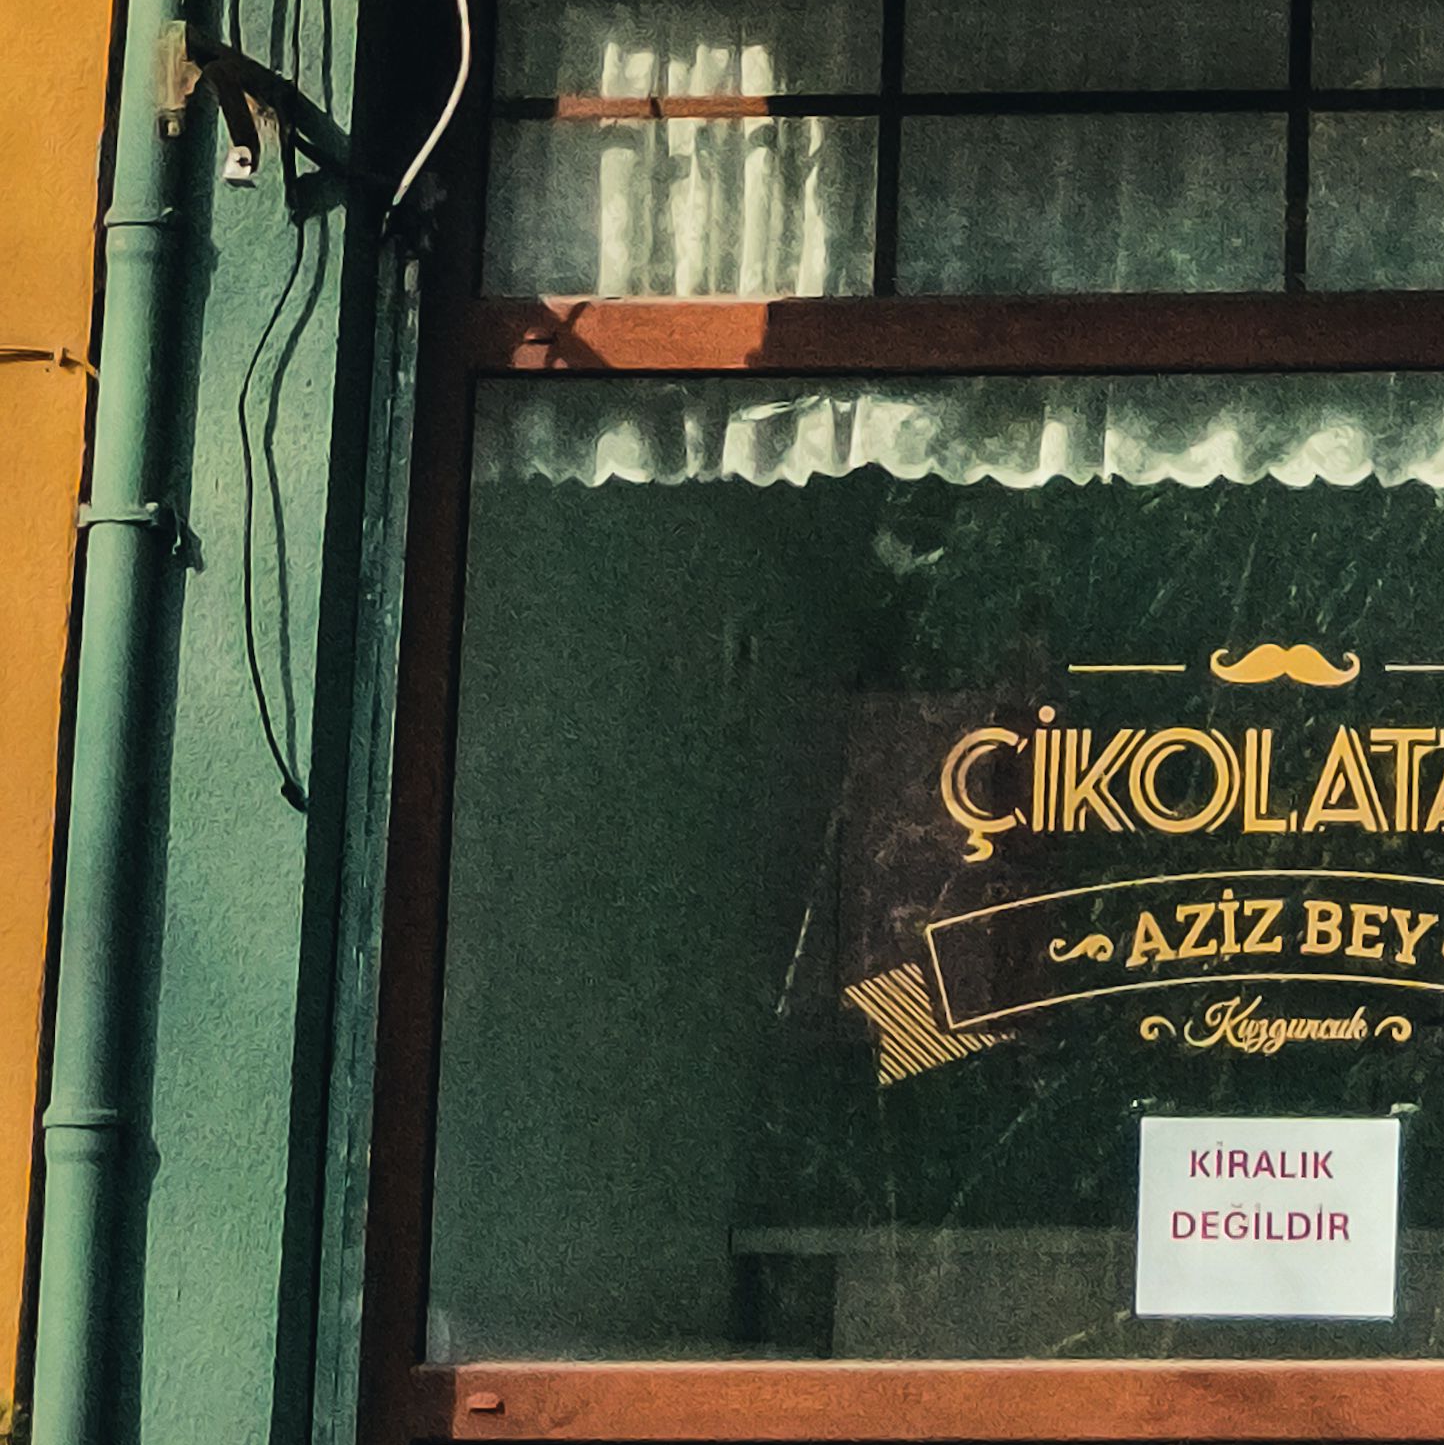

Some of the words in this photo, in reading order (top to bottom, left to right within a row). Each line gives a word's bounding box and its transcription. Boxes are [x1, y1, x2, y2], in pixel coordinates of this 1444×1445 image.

[1126, 888, 1284, 968] AZİZ
[1301, 900, 1439, 965] BEY
[1189, 1140, 1334, 1179] KİRALIK
[1171, 1202, 1351, 1241] DEĞİLDİR
